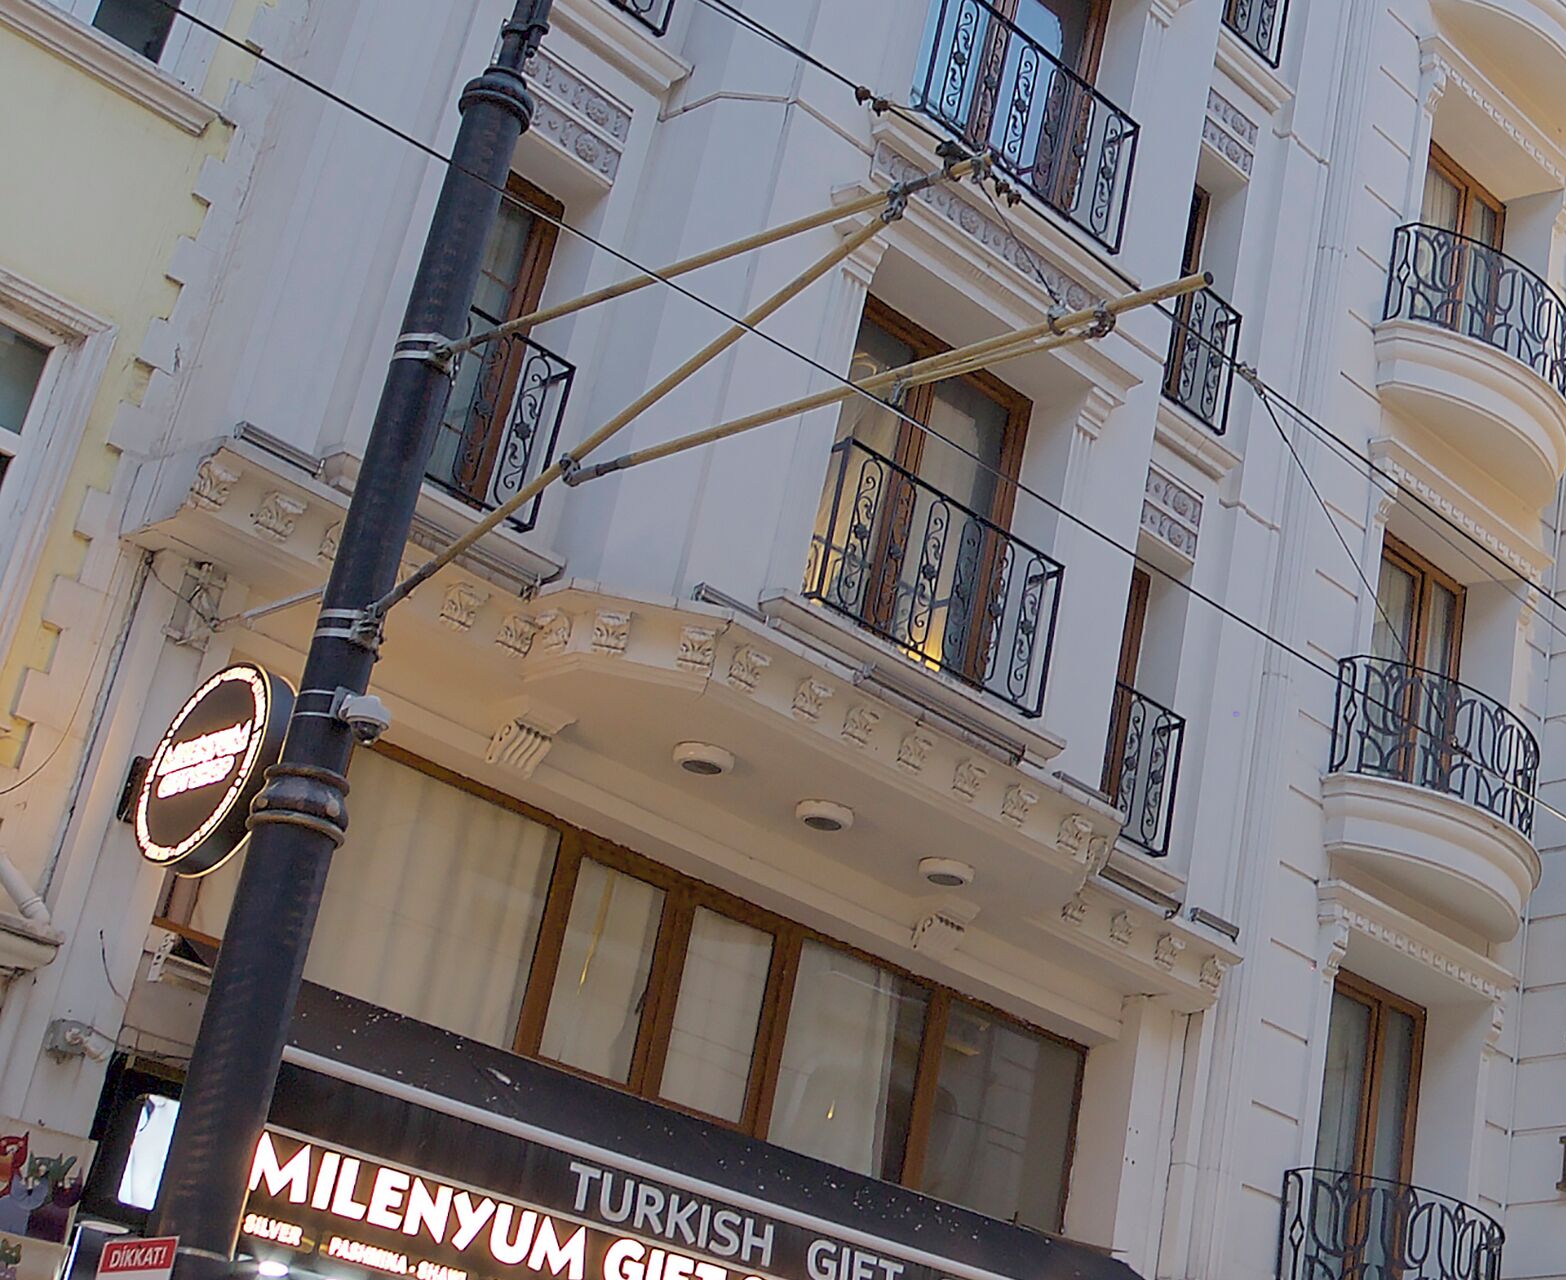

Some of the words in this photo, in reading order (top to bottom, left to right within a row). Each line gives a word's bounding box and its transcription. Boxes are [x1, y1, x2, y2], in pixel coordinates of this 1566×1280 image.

[249, 1131, 585, 1280] MILENYUM
[569, 1161, 774, 1267] TURKISH
[243, 1214, 303, 1246] SILVER
[109, 1246, 168, 1269] DİKKAT!
[328, 1236, 408, 1275] PASHMINA
